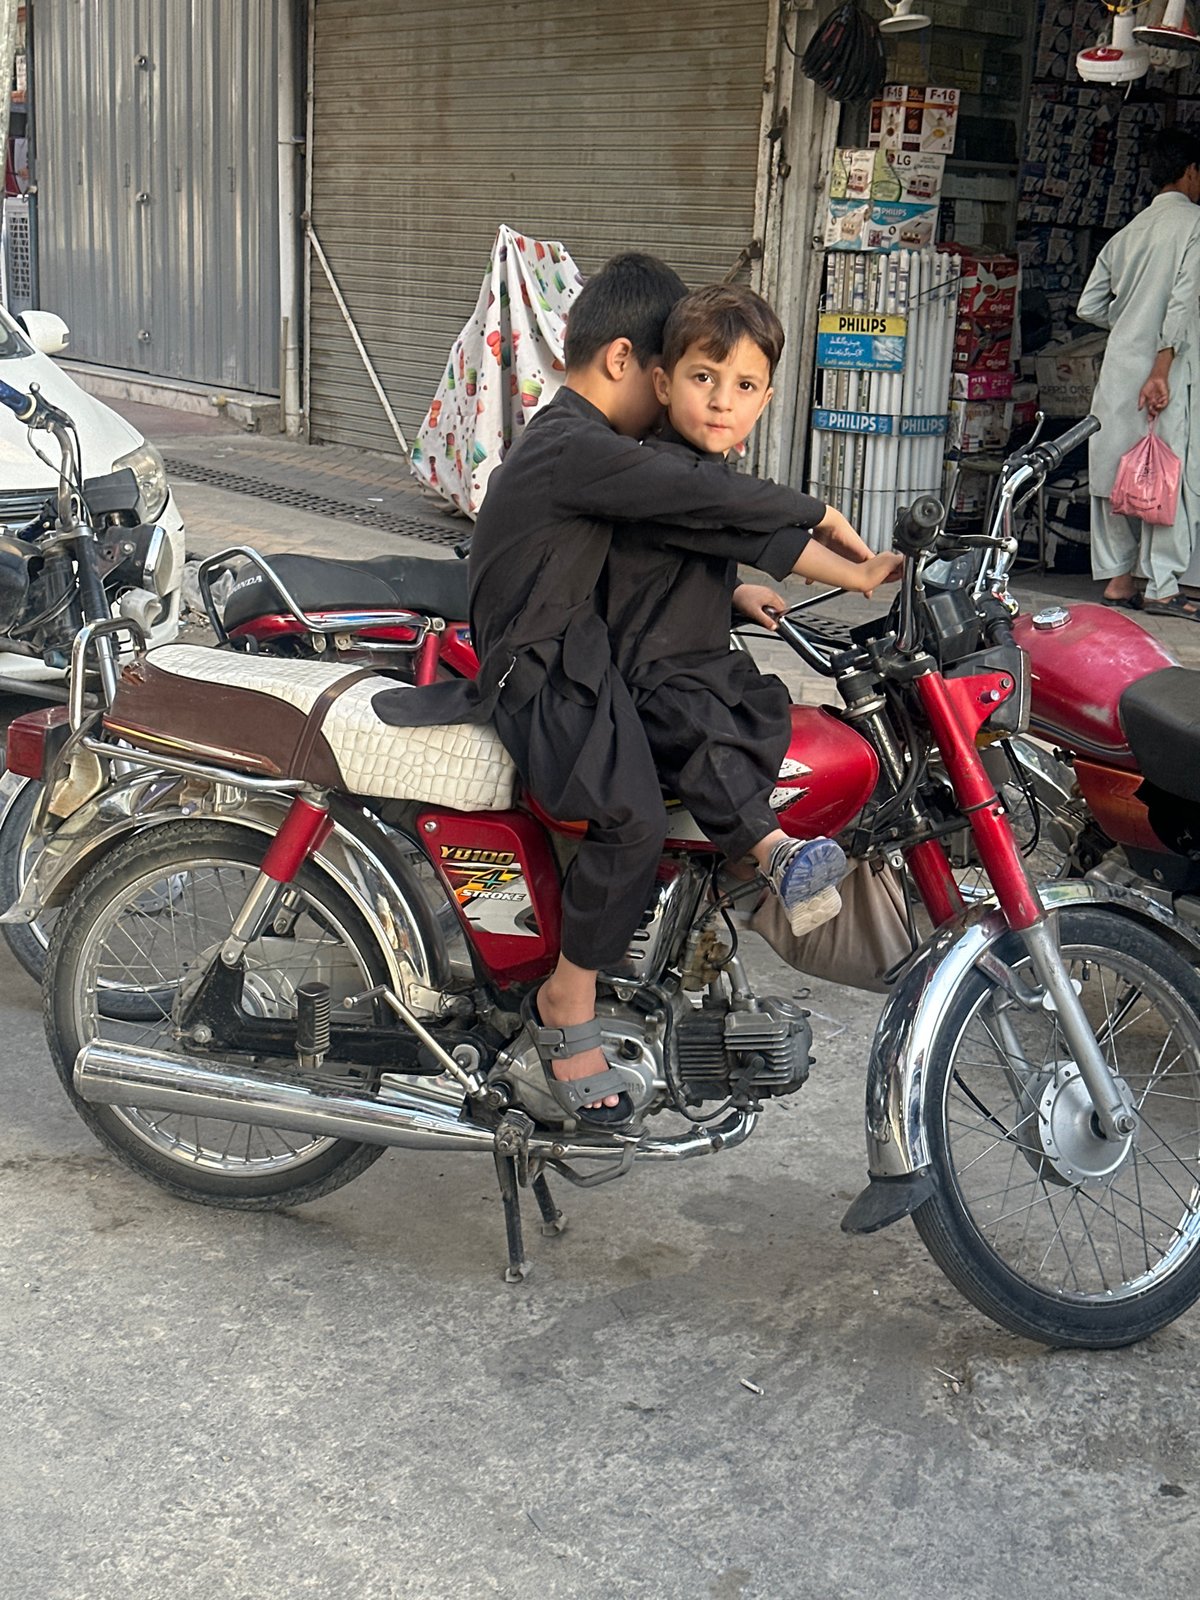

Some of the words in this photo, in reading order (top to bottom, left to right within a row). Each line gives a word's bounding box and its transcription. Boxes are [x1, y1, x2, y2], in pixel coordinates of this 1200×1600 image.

[930, 89, 956, 101] F-16
[897, 154, 911, 166] LG
[882, 207, 907, 217] PHILIPS
[838, 316, 887, 333] PHILIPS
[828, 412, 877, 432] PHILIPS
[902, 418, 945, 433] PHILIPS
[470, 867, 507, 890] 4
[461, 889, 527, 902] STROKE
